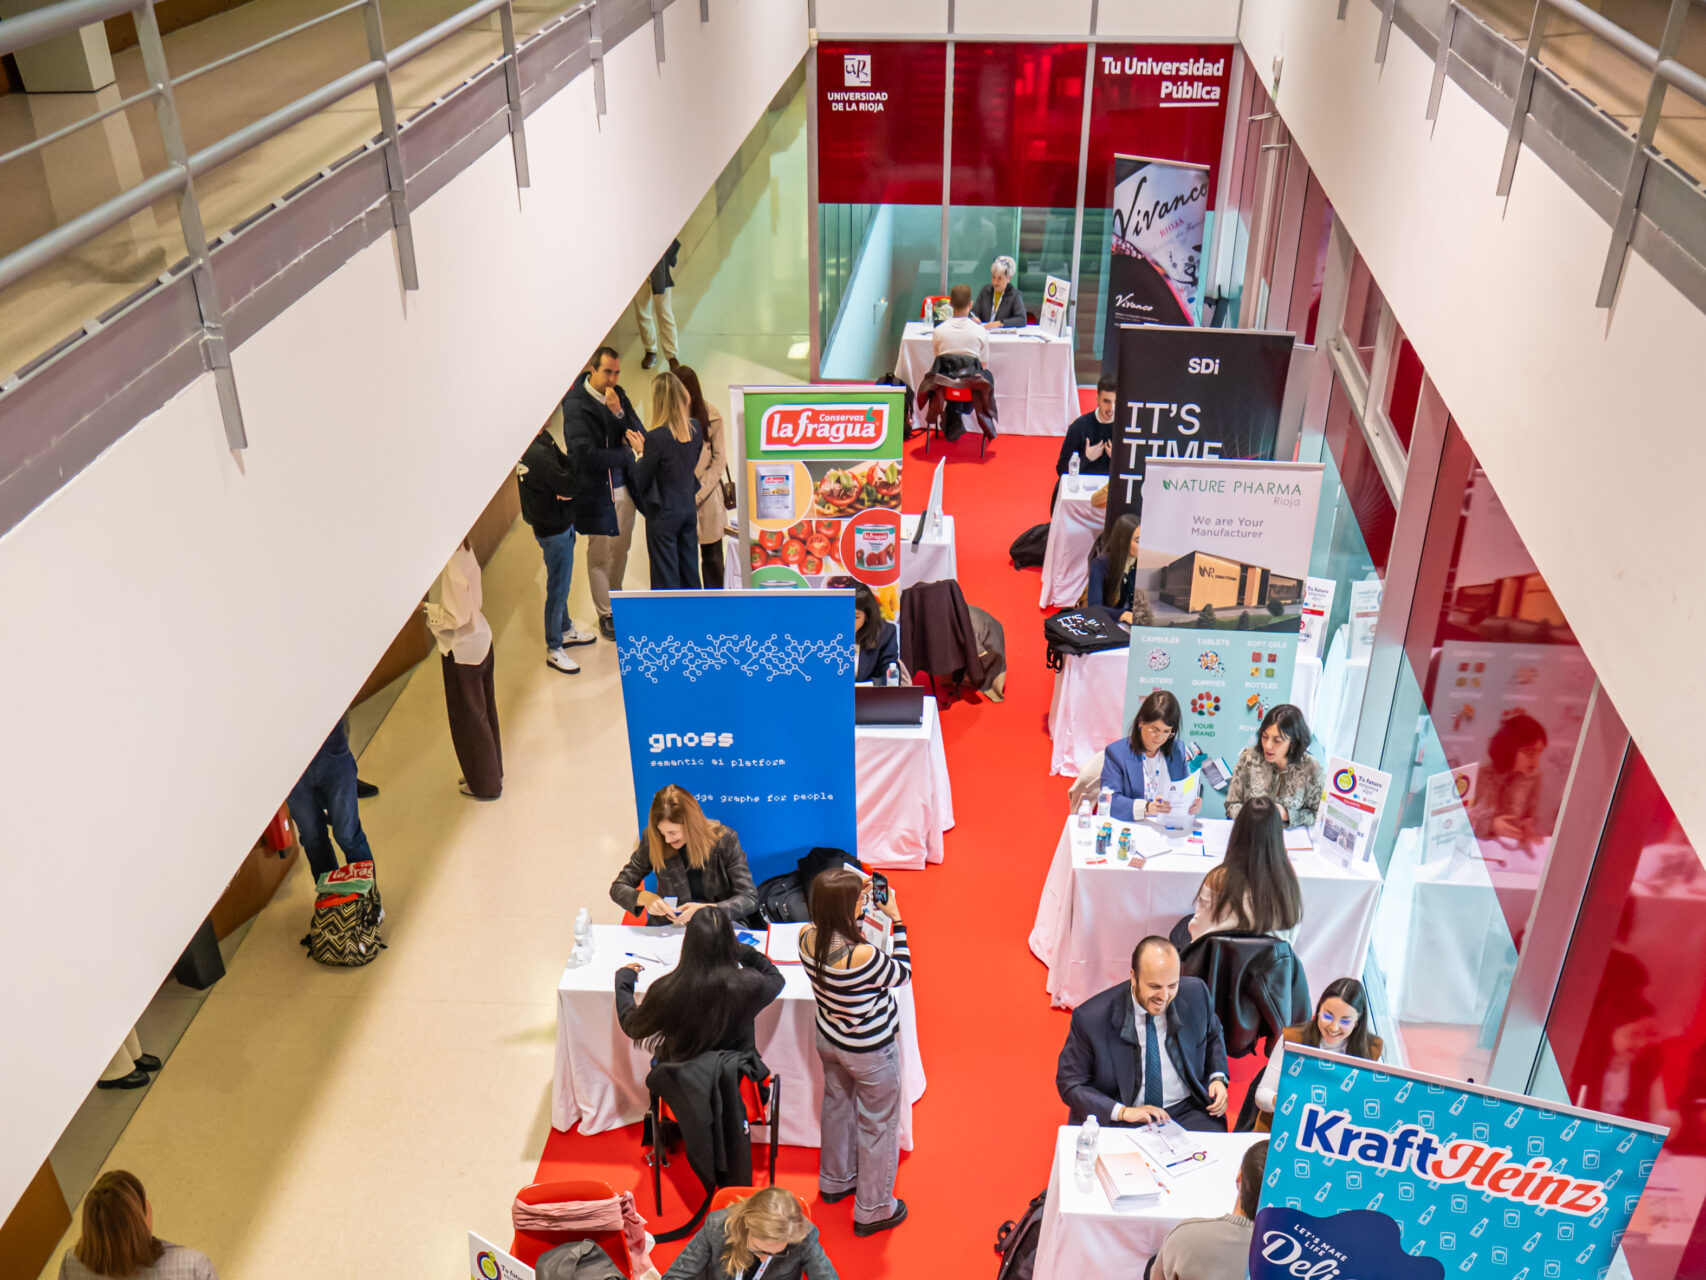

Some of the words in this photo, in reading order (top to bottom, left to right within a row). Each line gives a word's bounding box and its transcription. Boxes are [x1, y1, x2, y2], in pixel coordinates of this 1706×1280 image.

[1102, 56, 1120, 74] Tu
[1124, 57, 1224, 76] Universidad
[1160, 80, 1220, 99] Pública
[827, 92, 888, 100] UNIVERSIDAD
[832, 102, 844, 111] DE
[846, 102, 858, 111] LA
[859, 102, 884, 113] RIOJA
[1114, 176, 1208, 241] Vivanco
[1115, 293, 1153, 312] Vivanco
[1188, 357, 1220, 375] SDi
[820, 414, 864, 422] Conservas
[1122, 438, 1222, 469] TIME
[1167, 480, 1226, 493] NATURE
[1234, 480, 1302, 496] PHARMA
[1274, 497, 1300, 508] Rioja
[1193, 516, 1211, 526] We
[1215, 518, 1233, 526] are
[1238, 518, 1264, 528] Your
[1191, 527, 1263, 539] Manufacturer
[1141, 636, 1180, 644] CAPSULES
[1197, 638, 1230, 646] TABLETS
[1247, 640, 1267, 648] SOFT
[1139, 676, 1174, 684] BLISTERS
[1244, 682, 1278, 690] BOTTLES
[648, 732, 734, 752] gnoss
[650, 758, 704, 766] semantic
[712, 758, 724, 766] ai
[731, 758, 786, 768] platform
[720, 794, 760, 804] graphs
[767, 794, 786, 802] for
[794, 792, 834, 802] people
[1294, 1224, 1320, 1244] LET'S
[1320, 1242, 1348, 1262] MAKE
[1304, 1240, 1326, 1257] LIFE
